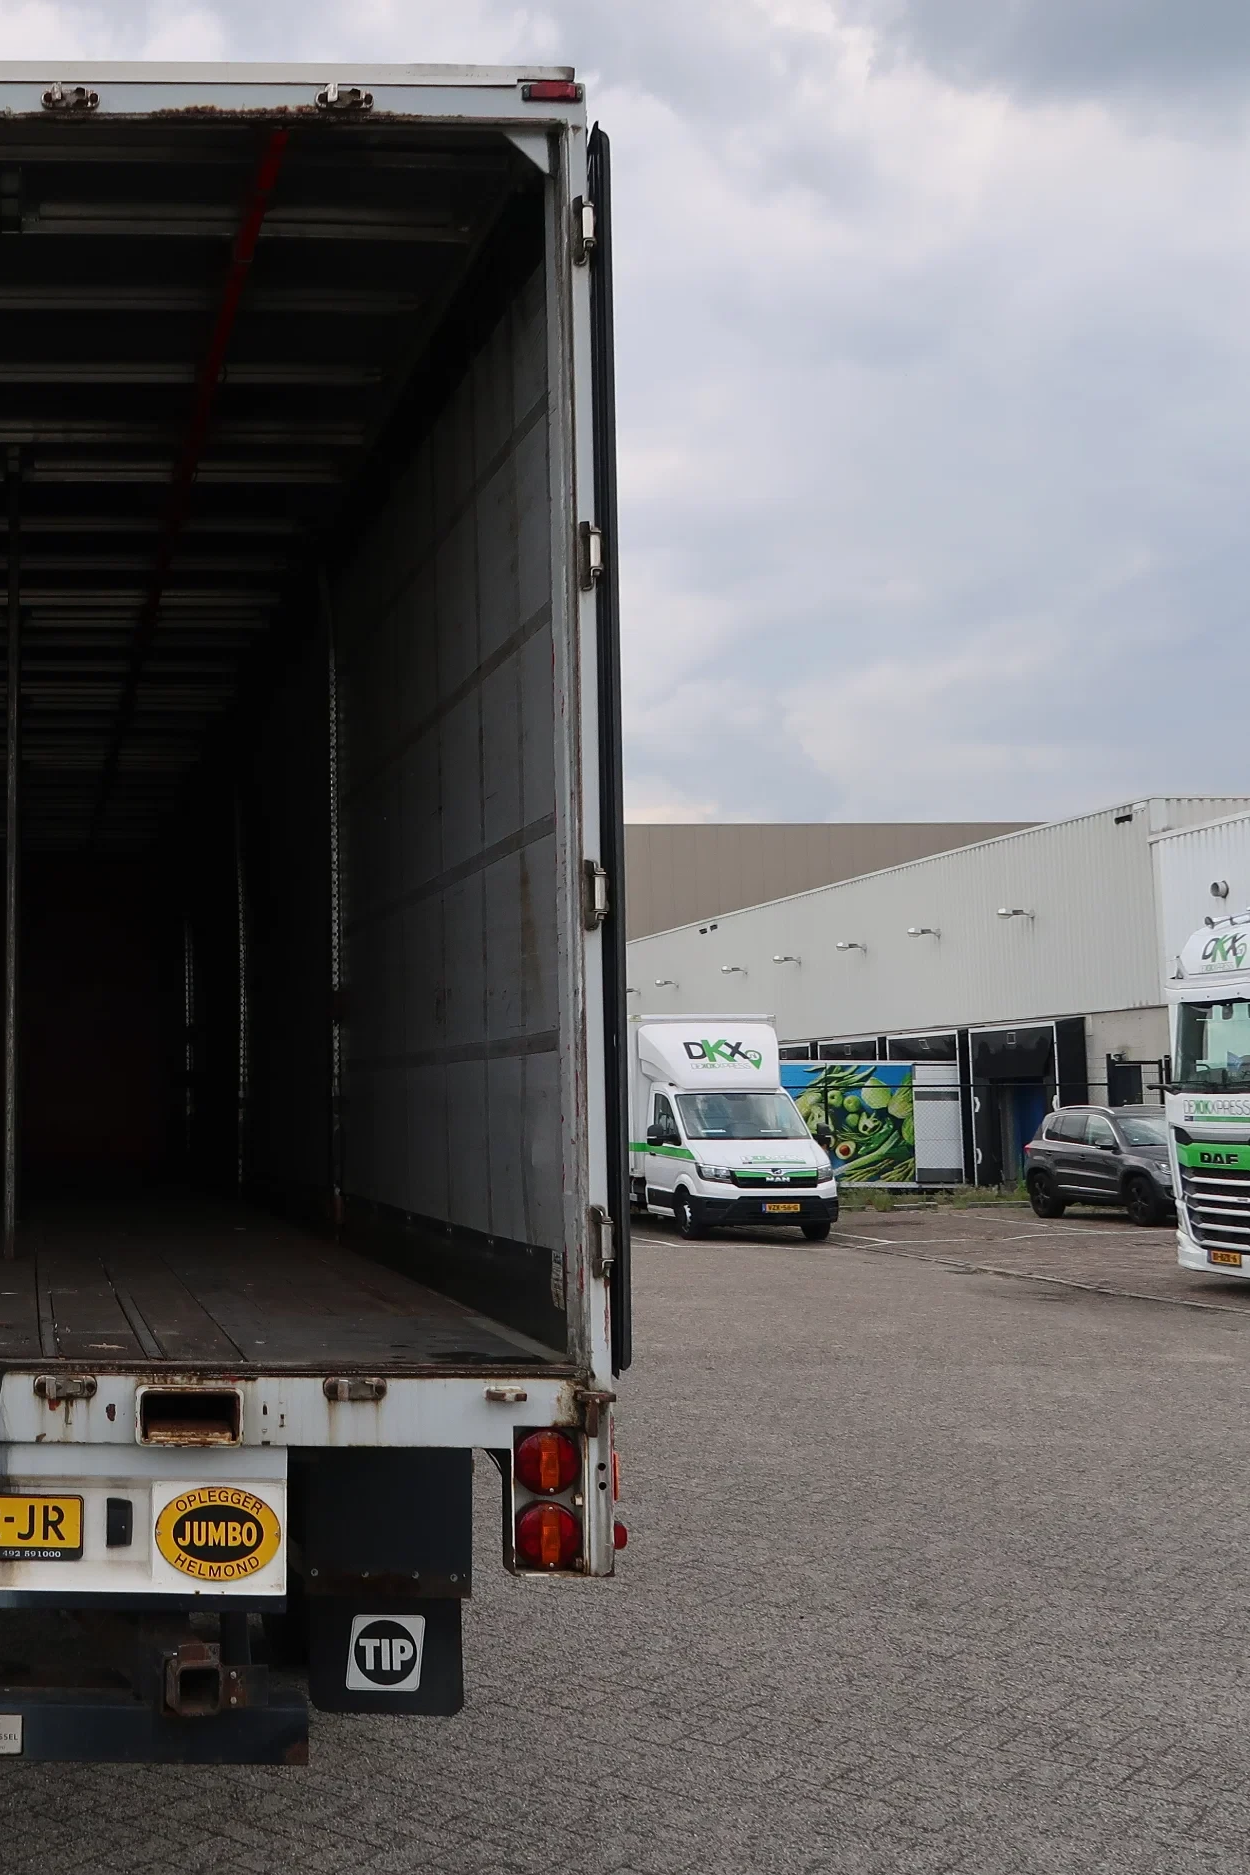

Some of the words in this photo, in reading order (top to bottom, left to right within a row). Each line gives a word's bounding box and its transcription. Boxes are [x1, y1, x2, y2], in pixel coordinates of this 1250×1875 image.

[682, 1039, 750, 1063] DKX
[1200, 1152, 1239, 1165] DAF
[175, 1490, 263, 1515] OPLEGGER
[177, 1521, 257, 1547] JUMBO
[174, 1553, 260, 1578] HELMOND
[359, 1638, 414, 1671] TIP
